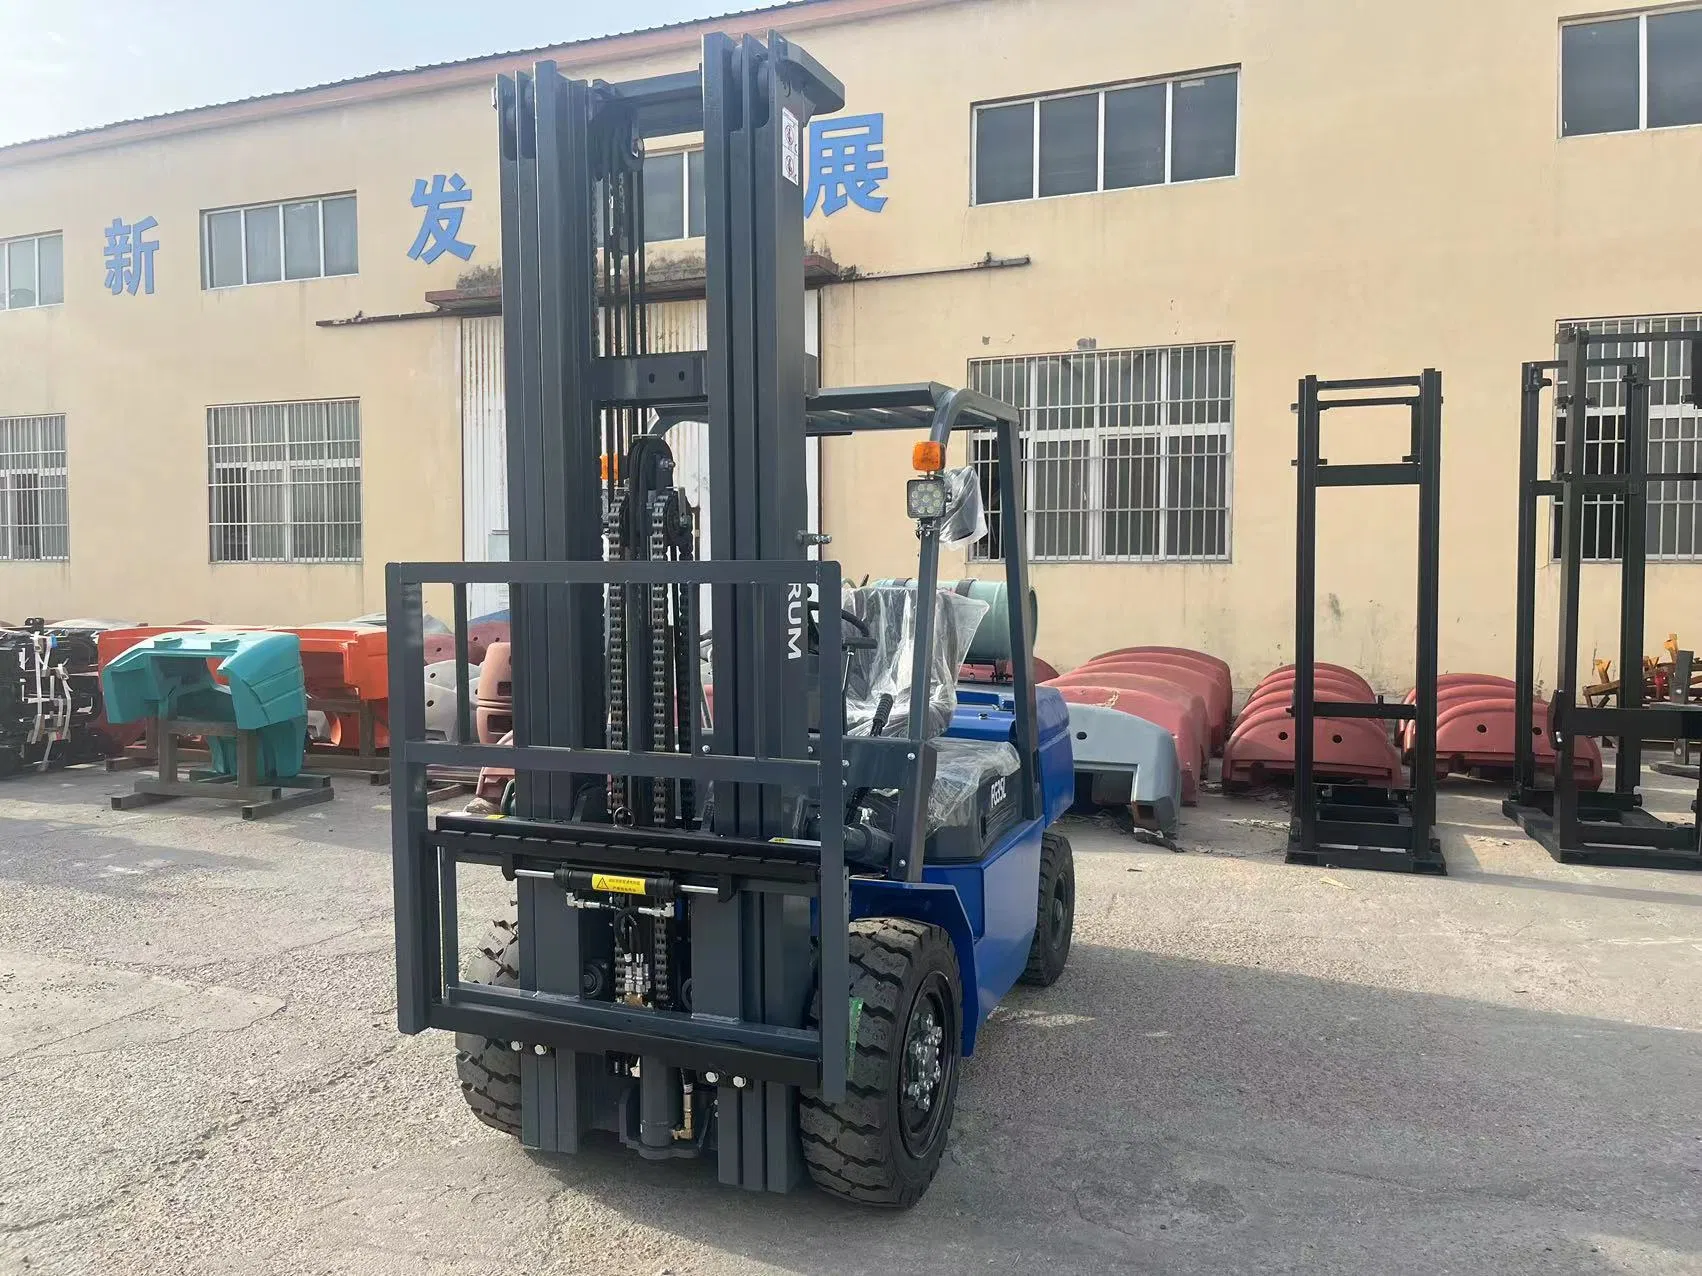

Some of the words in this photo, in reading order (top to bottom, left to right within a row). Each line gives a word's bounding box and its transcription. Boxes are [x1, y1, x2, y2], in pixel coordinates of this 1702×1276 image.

[103, 216, 160, 297] 新
[406, 172, 477, 265] 发
[804, 112, 888, 219] 展
[787, 582, 802, 660] RUM
